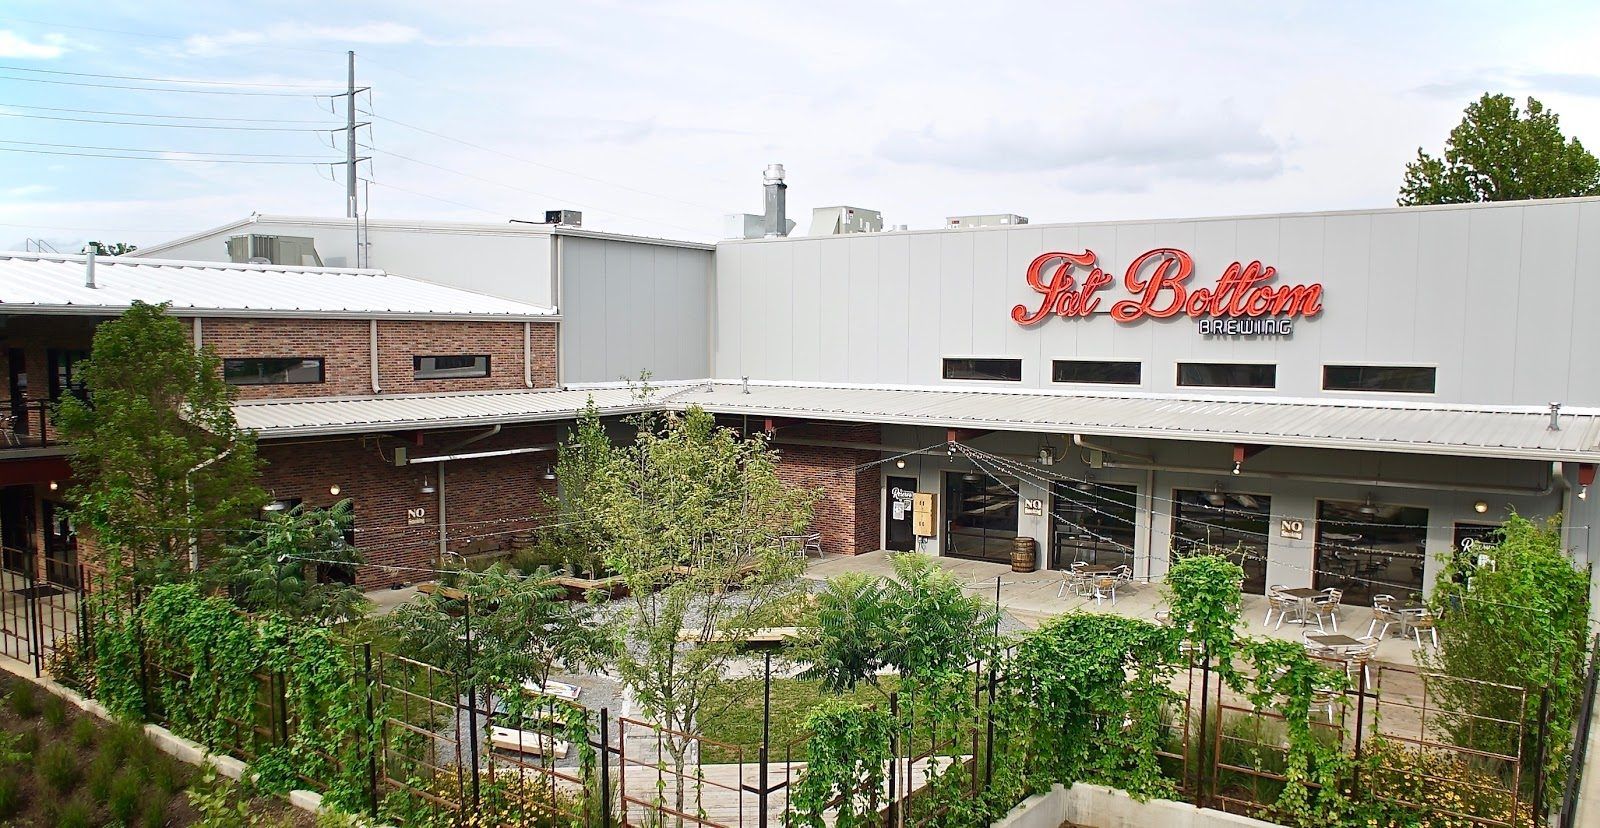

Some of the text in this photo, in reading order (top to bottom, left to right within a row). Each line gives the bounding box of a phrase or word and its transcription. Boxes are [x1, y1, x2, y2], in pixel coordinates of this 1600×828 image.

[1011, 248, 1323, 326] Fat Bottom
[1199, 319, 1292, 335] BREWING
[1024, 499, 1042, 509] NO
[408, 507, 425, 518] NO
[1281, 520, 1303, 531] NO
